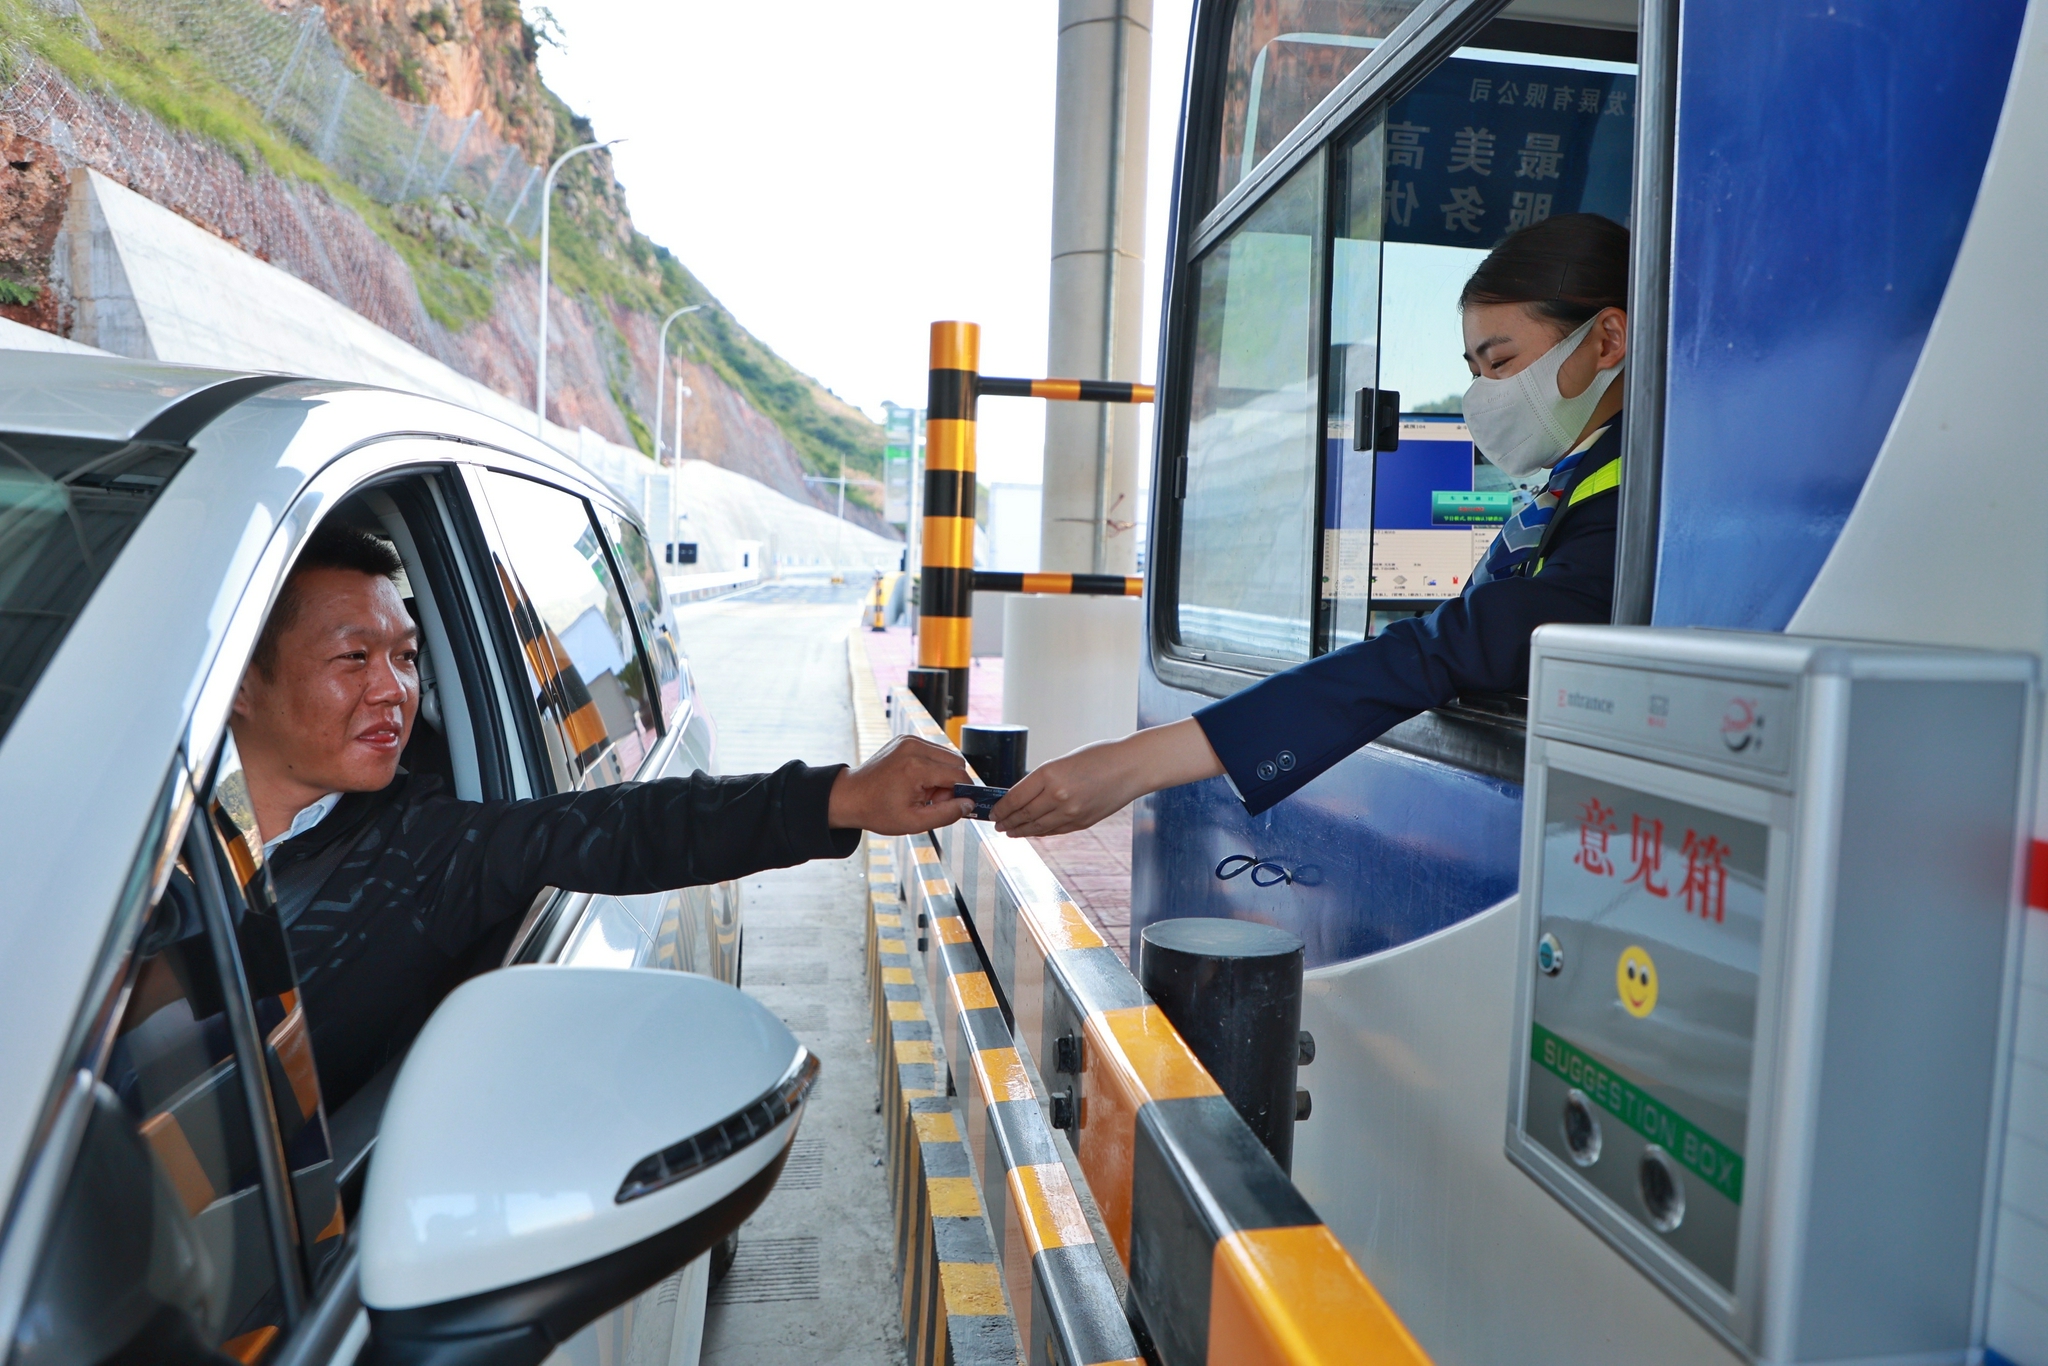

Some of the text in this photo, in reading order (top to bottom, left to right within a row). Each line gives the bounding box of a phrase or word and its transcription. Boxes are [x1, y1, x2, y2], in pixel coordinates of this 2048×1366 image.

[1573, 797, 1730, 925] 意见箱
[1543, 1038, 1735, 1189] SUGGESTION BOX
